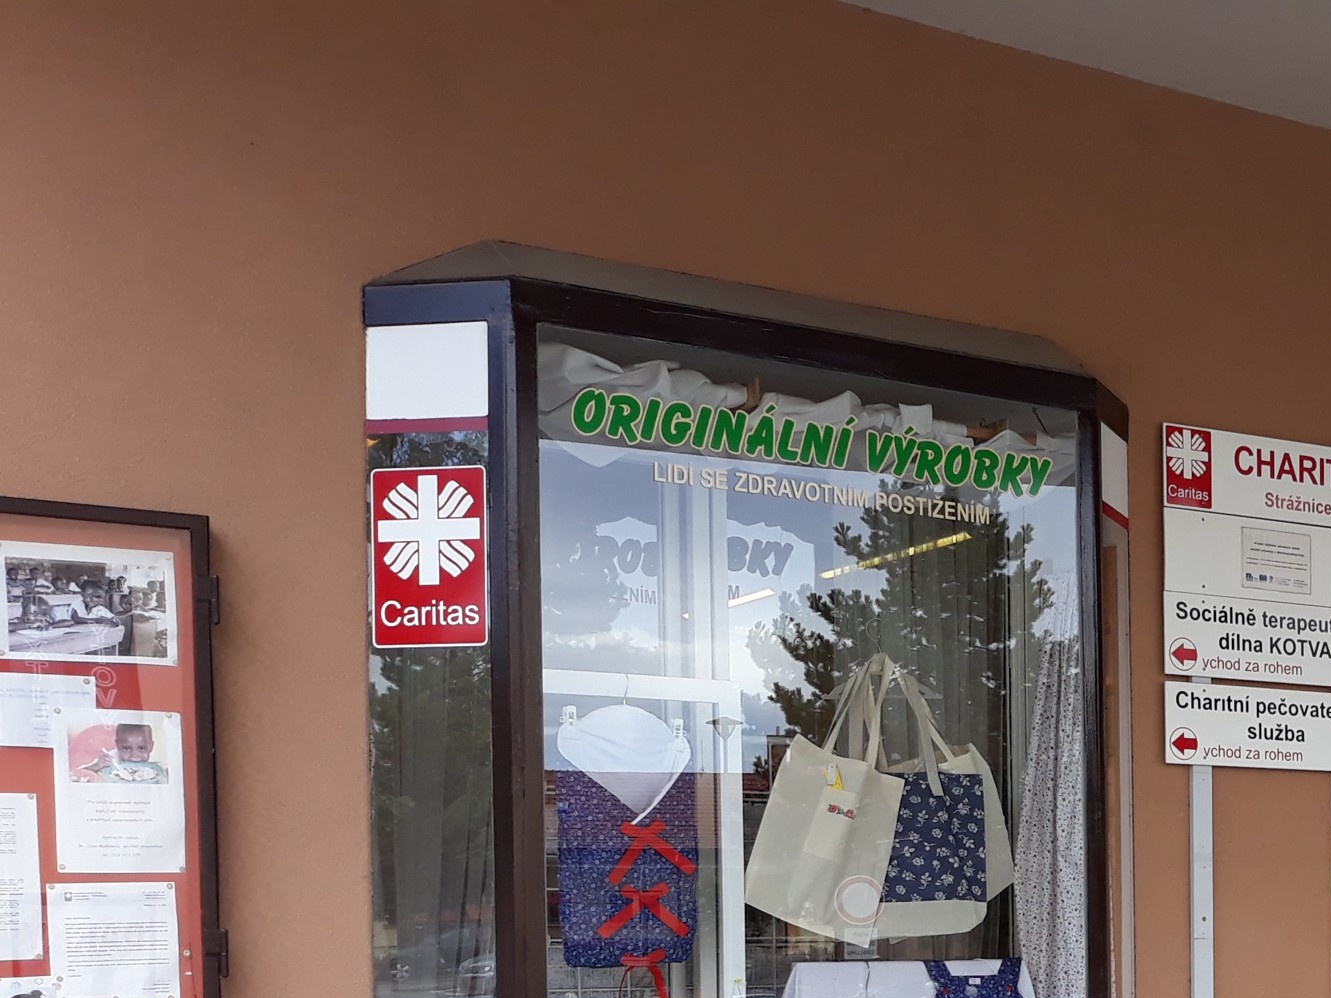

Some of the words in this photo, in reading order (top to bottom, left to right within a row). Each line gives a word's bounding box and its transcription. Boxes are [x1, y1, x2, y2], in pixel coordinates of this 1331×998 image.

[571, 387, 859, 470] ORIGINÁLNÍ
[866, 424, 1052, 498] VÝROBKY
[700, 468, 728, 490] SE
[734, 471, 868, 509] ZDRAVOTNÍM
[875, 491, 991, 525] POSTIŽENÍM
[1167, 484, 1209, 501] Caritas
[1265, 491, 1331, 515] Strážnice
[380, 599, 480, 627] Caritas
[1175, 601, 1257, 627] Sociálně
[1219, 633, 1263, 653] dílna
[1269, 637, 1331, 659] KOTVA
[1245, 661, 1260, 673] za
[1263, 661, 1303, 676] rohem
[1175, 690, 1250, 713] Charitní
[1247, 723, 1306, 743] služba
[1246, 749, 1260, 761] za
[1264, 748, 1304, 762] rohem
